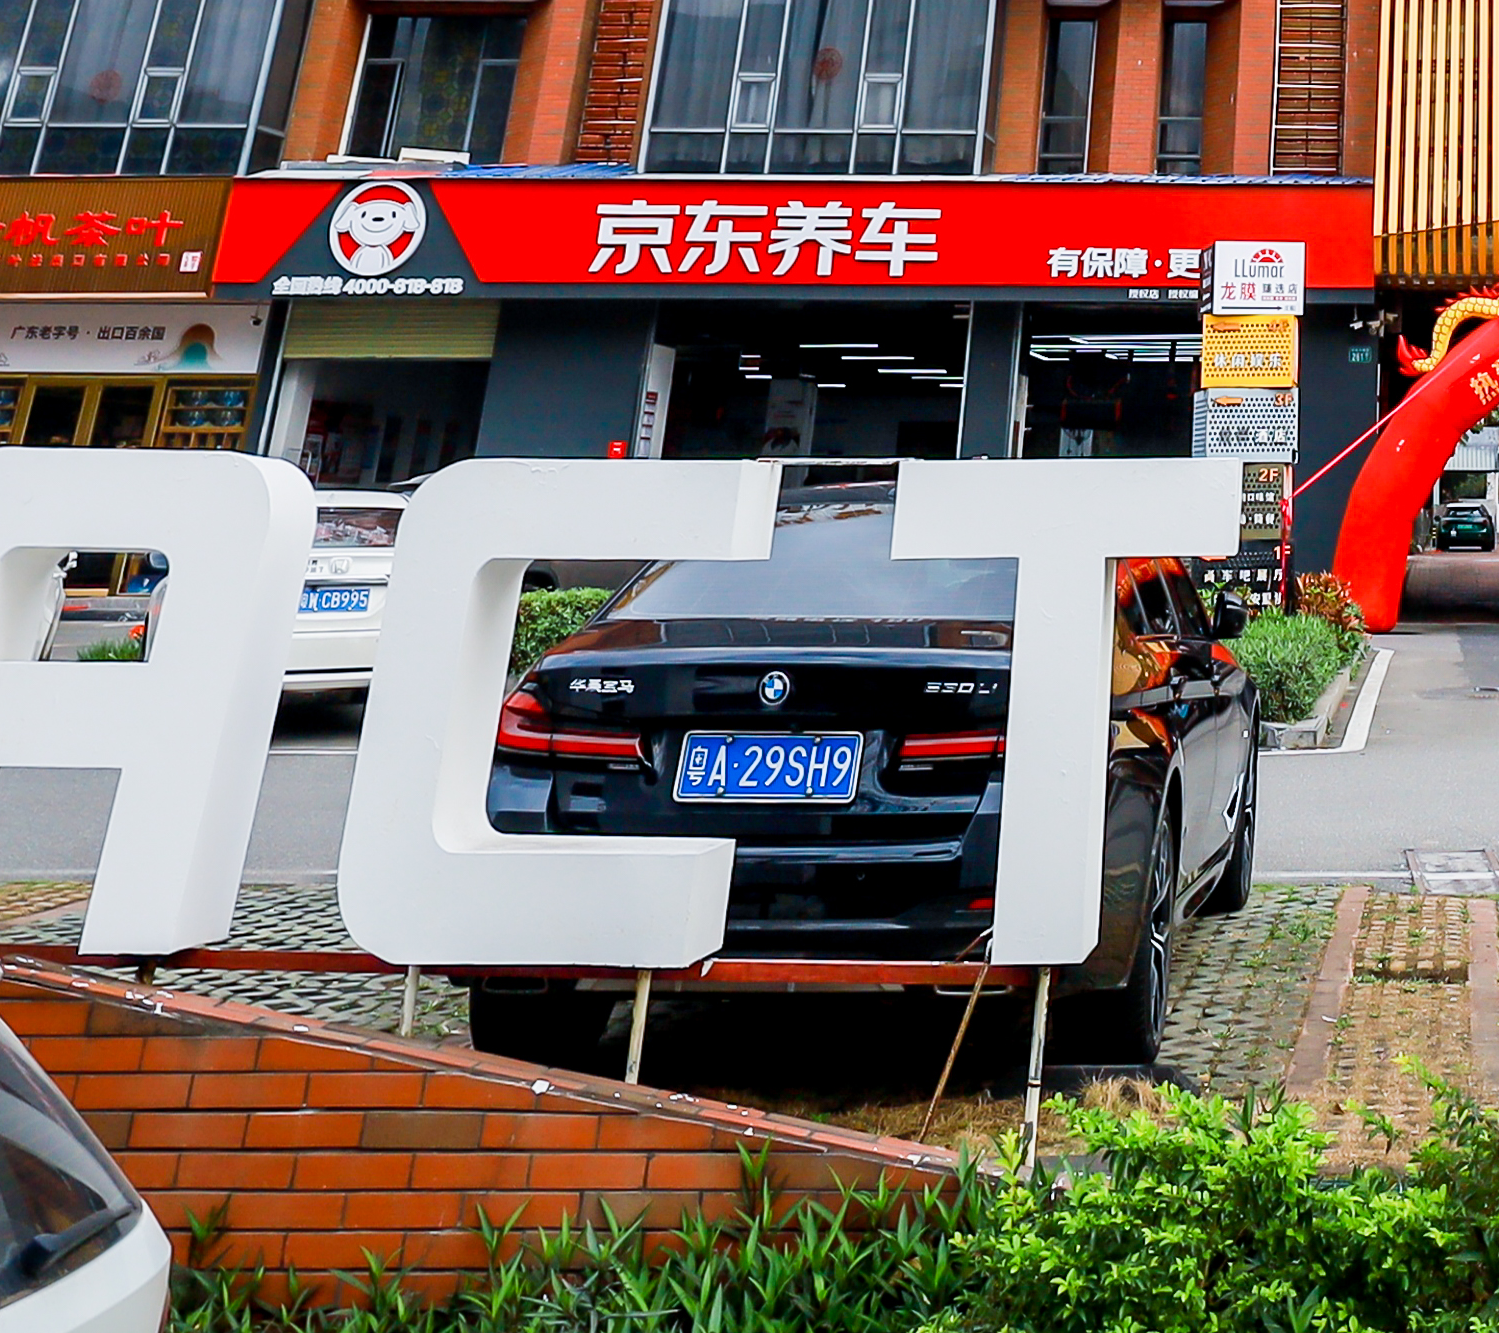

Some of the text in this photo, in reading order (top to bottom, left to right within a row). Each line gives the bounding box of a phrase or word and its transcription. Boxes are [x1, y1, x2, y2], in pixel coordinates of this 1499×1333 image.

[588, 199, 943, 279] 京东养车
[11, 325, 166, 341] 广东老字号 出口百余国
[1258, 468, 1279, 482] 2F
[569, 678, 636, 694] 华晨宝马
